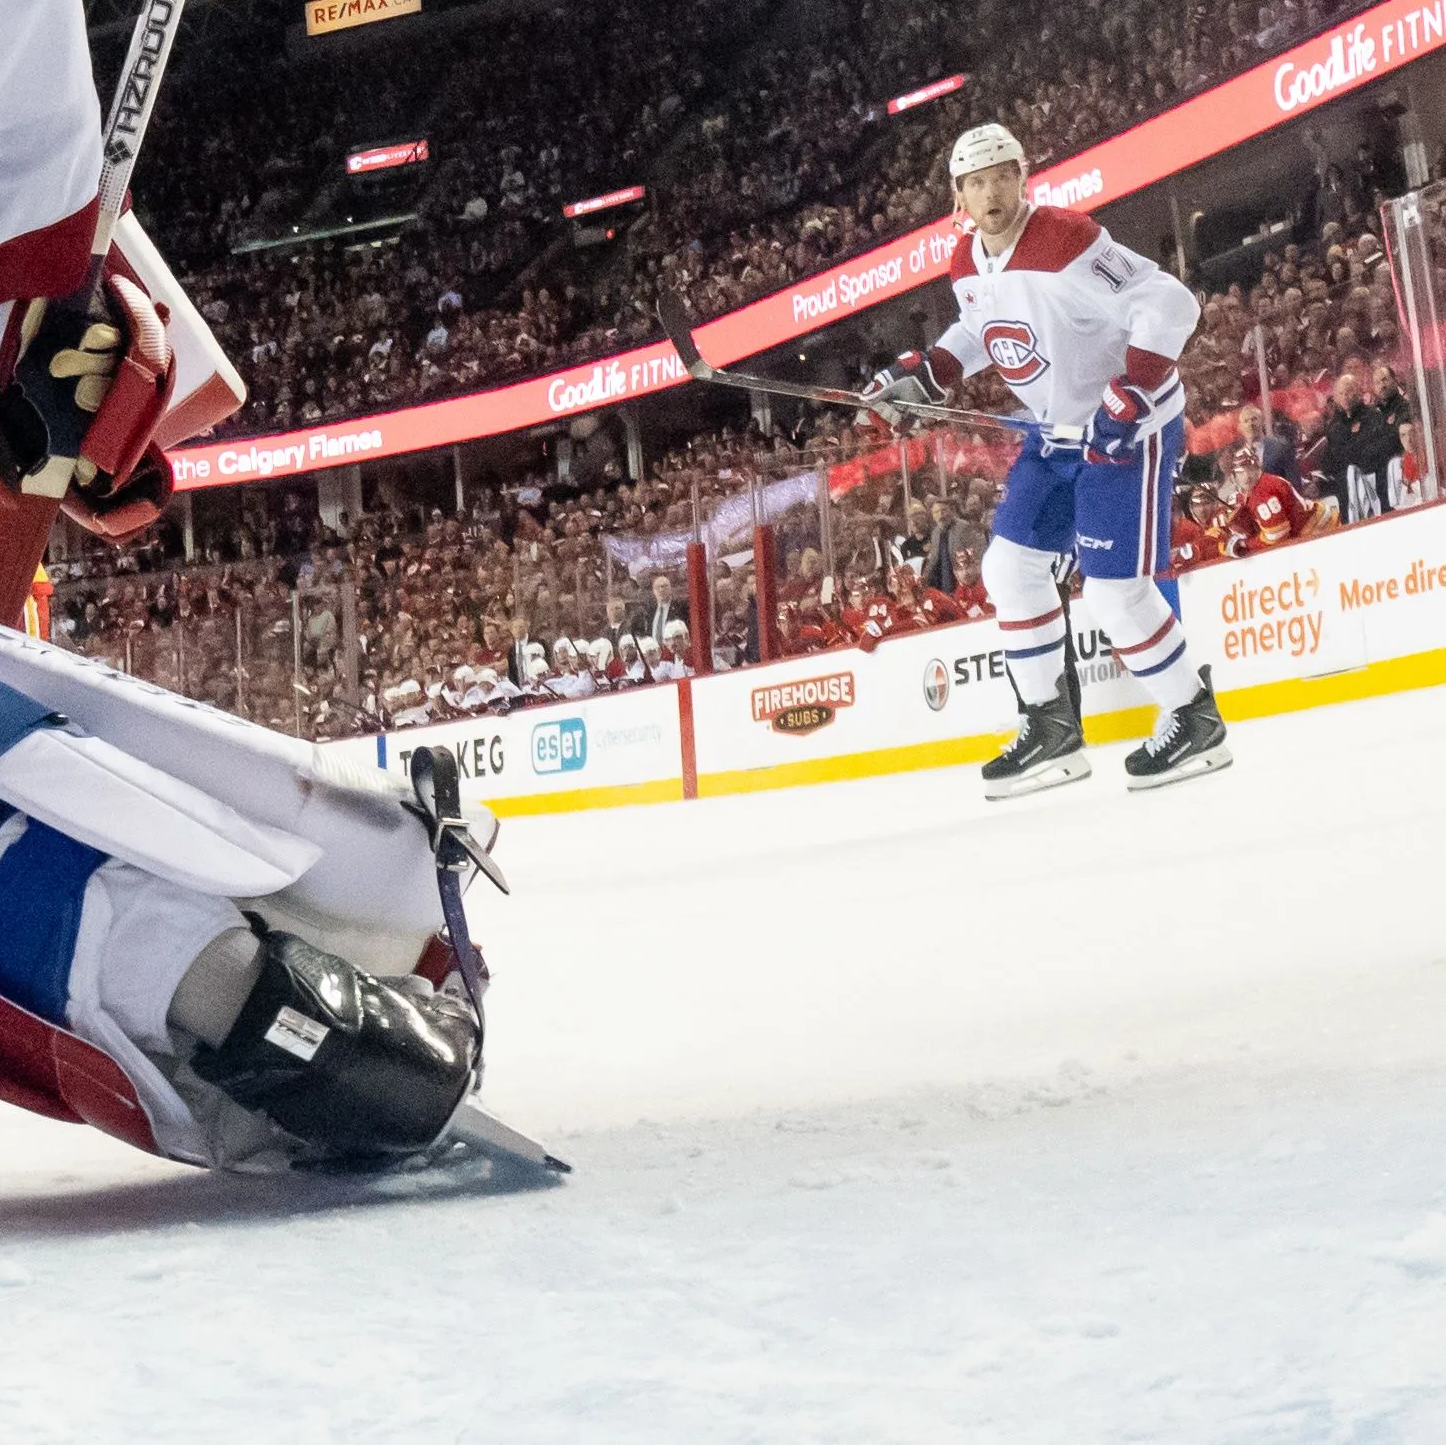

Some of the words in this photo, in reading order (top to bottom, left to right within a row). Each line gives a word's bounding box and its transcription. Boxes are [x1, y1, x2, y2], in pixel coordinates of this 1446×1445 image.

[1274, 23, 1378, 111] GoodLife
[792, 282, 838, 323] Proud
[839, 257, 904, 307] Sponsor
[909, 248, 926, 274] of
[929, 233, 957, 263] the
[548, 359, 627, 412] GoodLife
[174, 457, 210, 481] the
[218, 445, 306, 476] Calgary
[309, 429, 383, 461] Flames
[1221, 570, 1304, 624] direct
[1339, 577, 1399, 611] More
[1404, 558, 1446, 596] dire
[1223, 610, 1324, 661] energy
[753, 678, 853, 720] FIREHOUSE
[786, 708, 820, 728] SUBS
[456, 735, 505, 780] KEG
